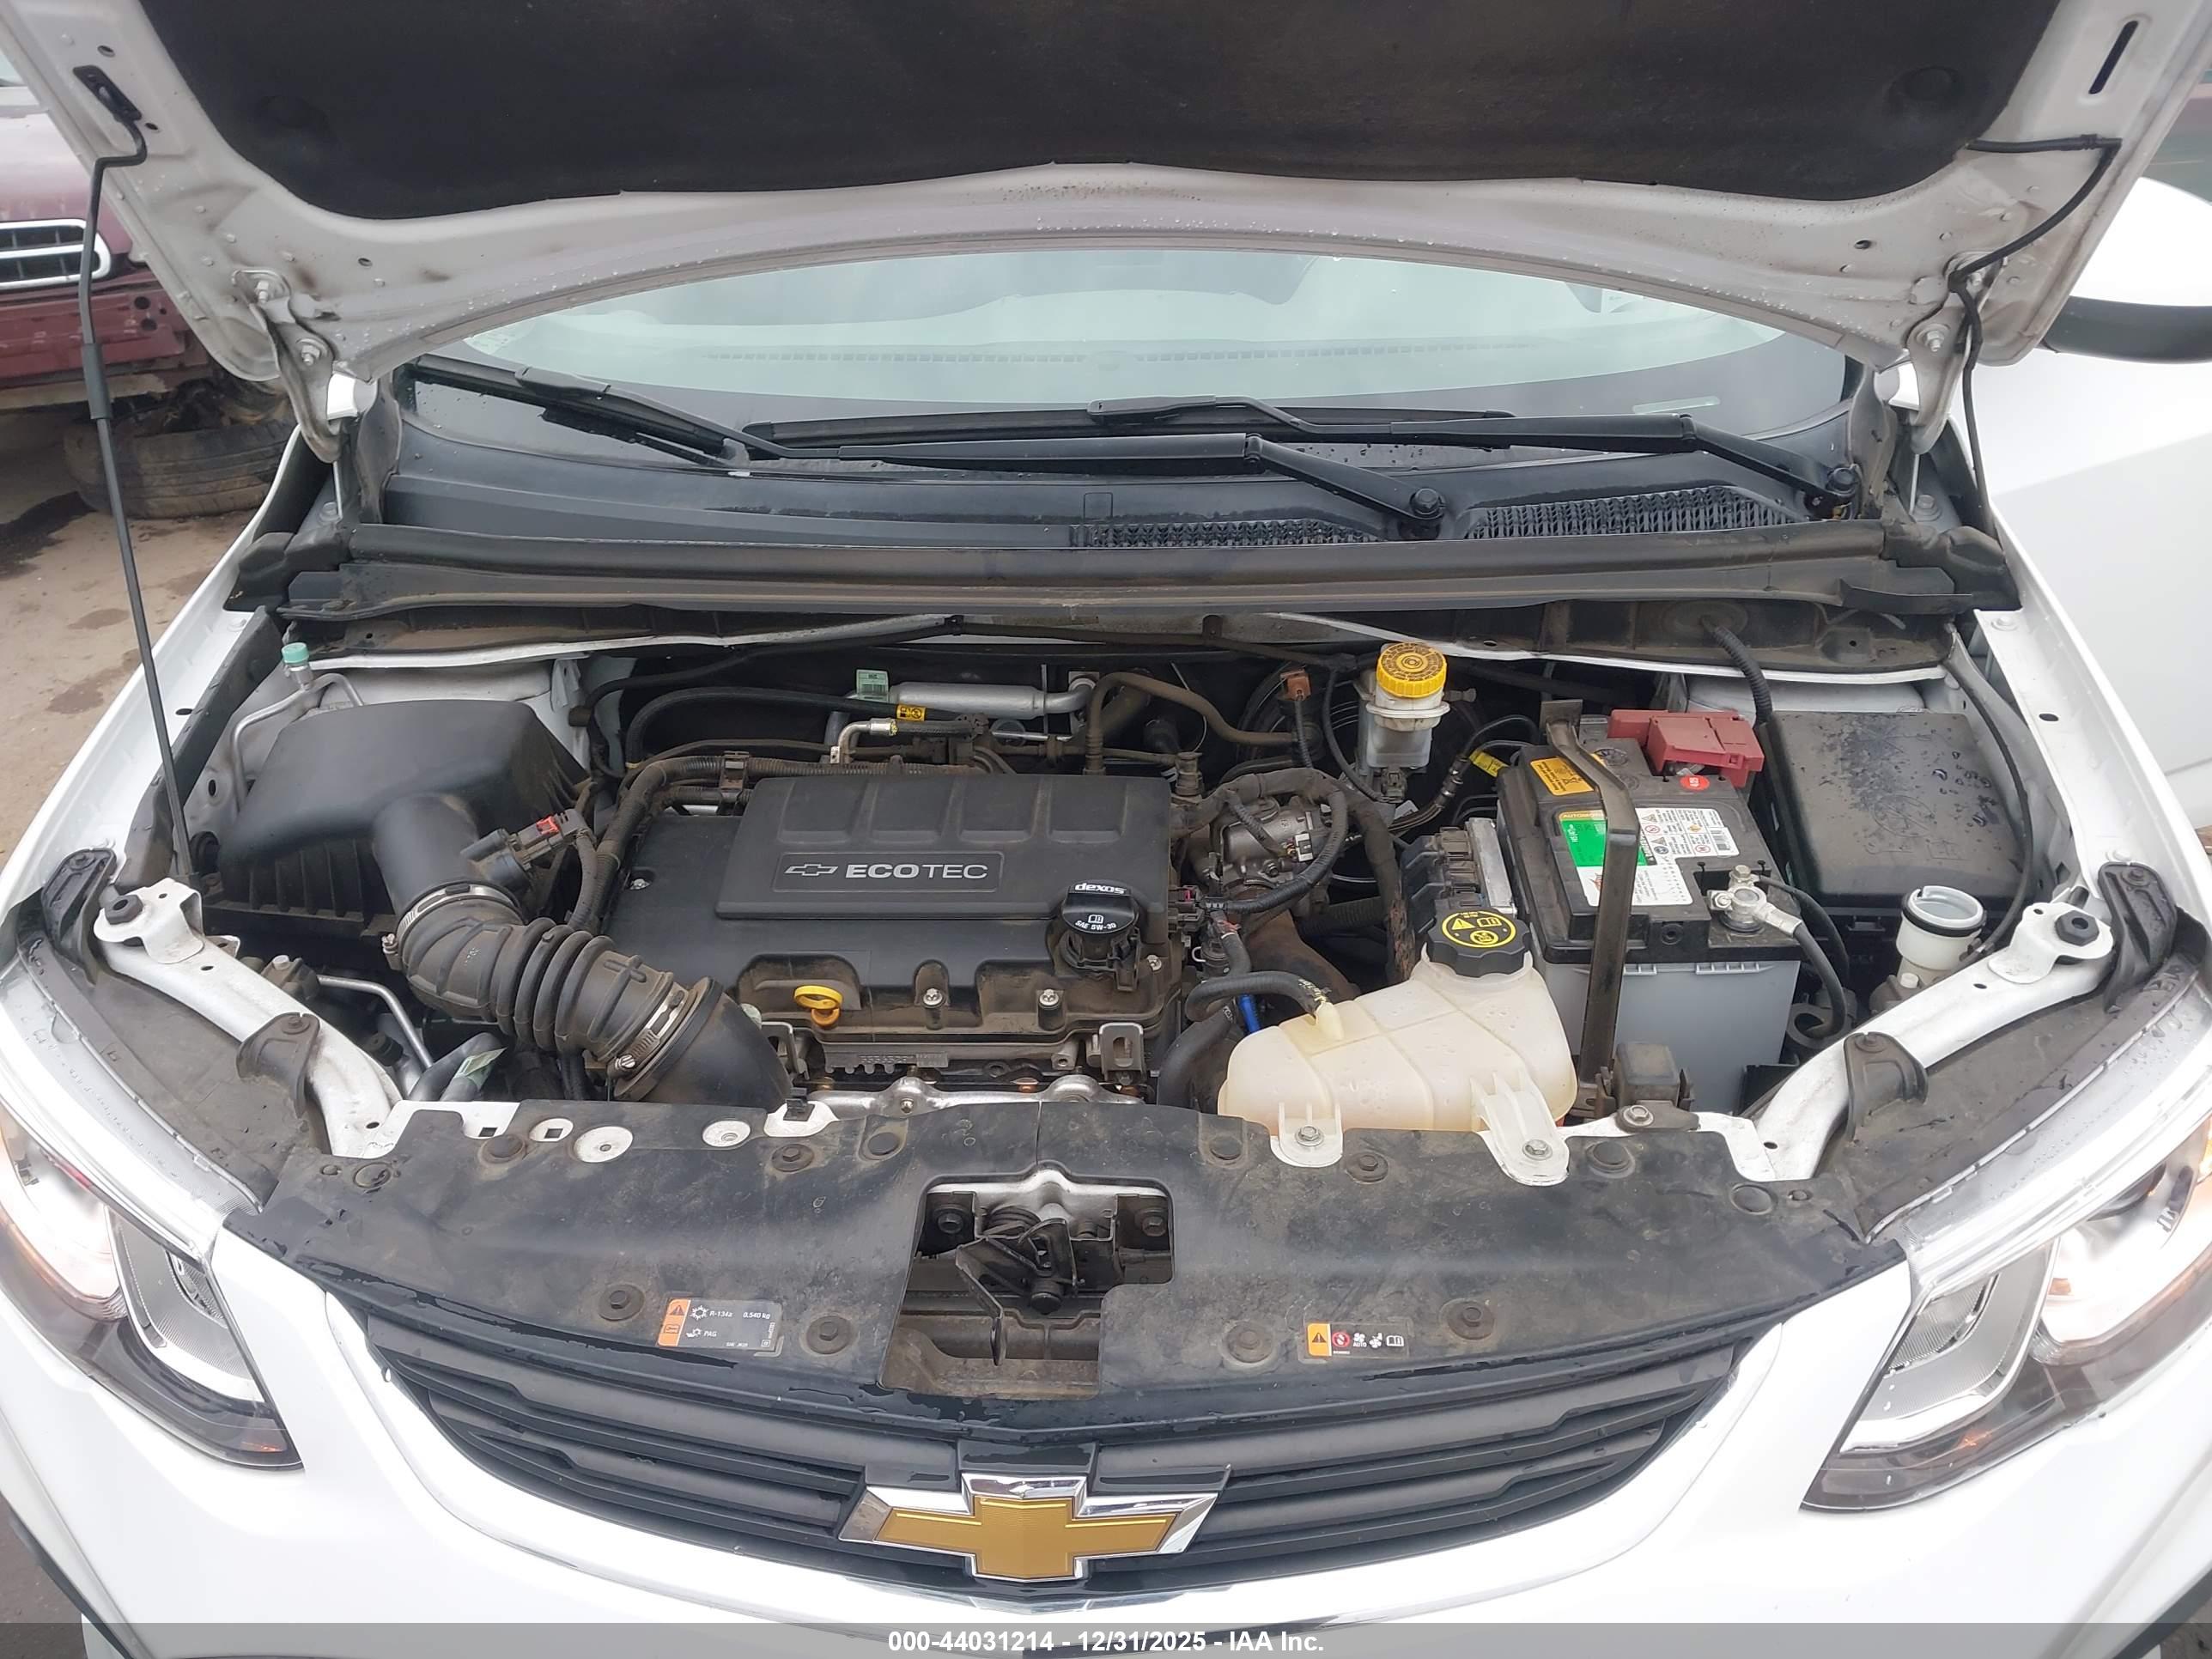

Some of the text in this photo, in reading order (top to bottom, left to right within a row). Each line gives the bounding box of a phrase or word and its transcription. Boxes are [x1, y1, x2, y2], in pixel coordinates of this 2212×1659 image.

[845, 864, 988, 879] ECOTEC
[1074, 883, 1127, 894] dexos
[1075, 921, 1090, 929] SAE
